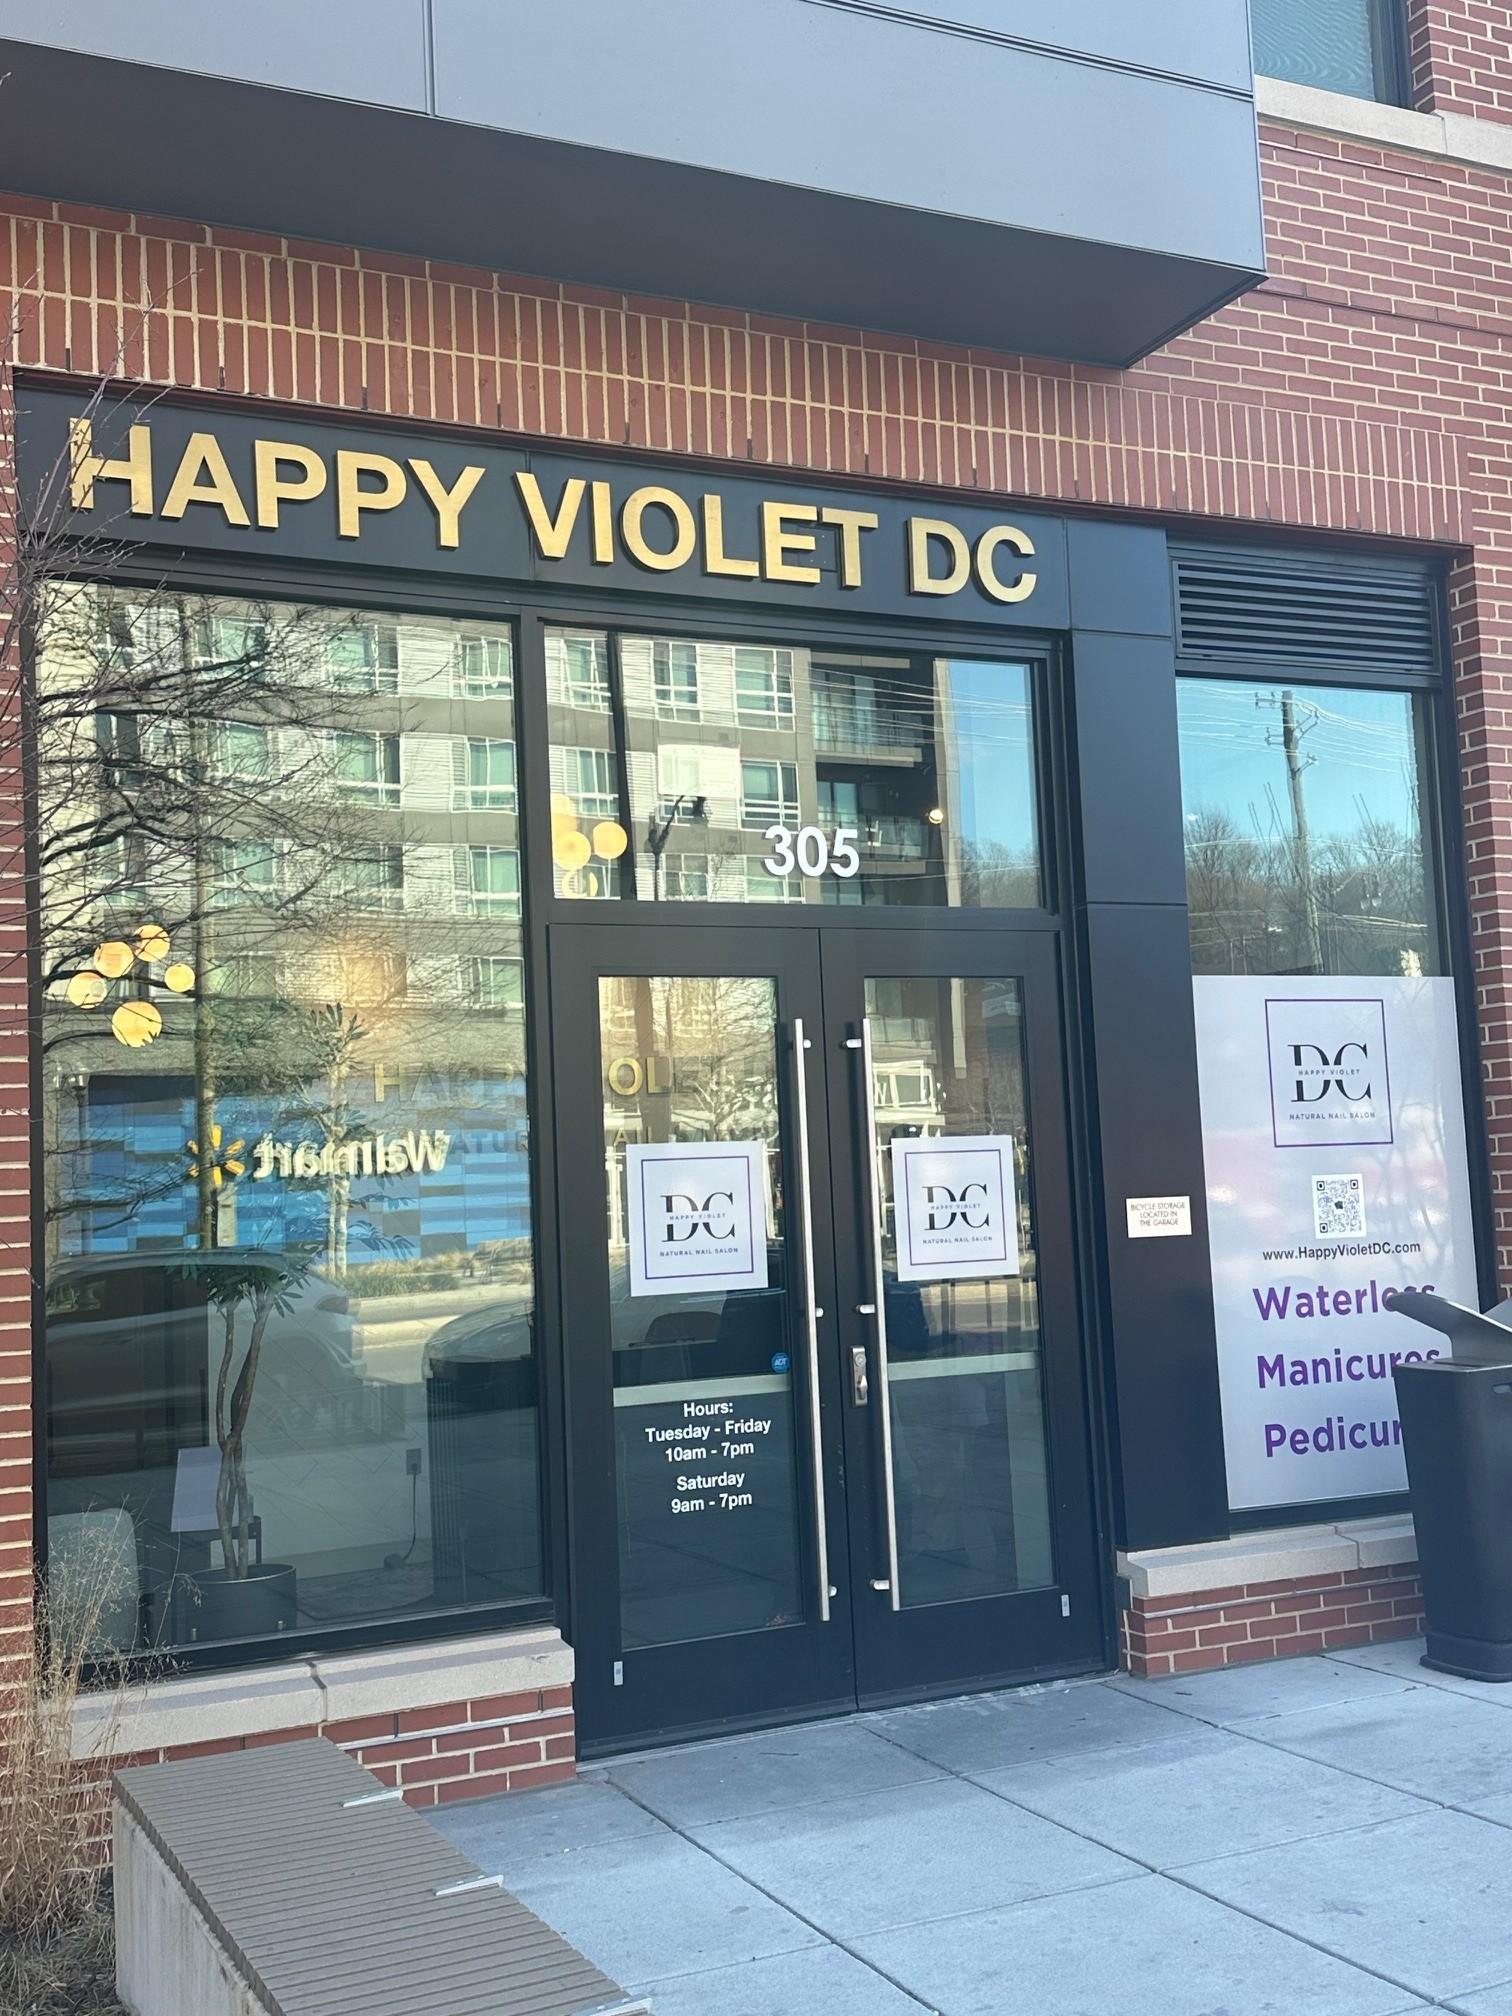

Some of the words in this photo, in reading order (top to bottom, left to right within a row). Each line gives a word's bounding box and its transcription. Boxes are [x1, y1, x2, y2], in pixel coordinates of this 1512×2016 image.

[68, 417, 486, 548] HAPPY
[514, 471, 879, 589] VIOLET
[906, 516, 1037, 603] DC
[763, 824, 860, 878] 305
[1286, 1042, 1372, 1103] DC
[1298, 1068, 1326, 1077] HAPPY
[1329, 1067, 1361, 1076] VIOLET
[1289, 1112, 1326, 1121] NATURAL
[1328, 1111, 1348, 1120] NAIL
[1349, 1110, 1376, 1119] SALON
[697, 1212, 726, 1220] VIOLET
[921, 1183, 990, 1231] DC
[955, 1202, 981, 1210] VIOLET
[659, 1191, 736, 1243] DC
[659, 1249, 693, 1257] NATURAL
[695, 1248, 713, 1256] NAIL
[1262, 1241, 1422, 1262] www.HappyVioletDC.com
[1252, 1279, 1436, 1321] Waterle
[683, 1402, 734, 1418] Hours:
[644, 1423, 711, 1443] Tuesday
[724, 1418, 772, 1436] Friday
[665, 1446, 707, 1462] 10am
[720, 1441, 755, 1459] 7pm
[676, 1471, 745, 1491] Saturday
[671, 1498, 705, 1514] 9am
[718, 1493, 753, 1510] 7pm
